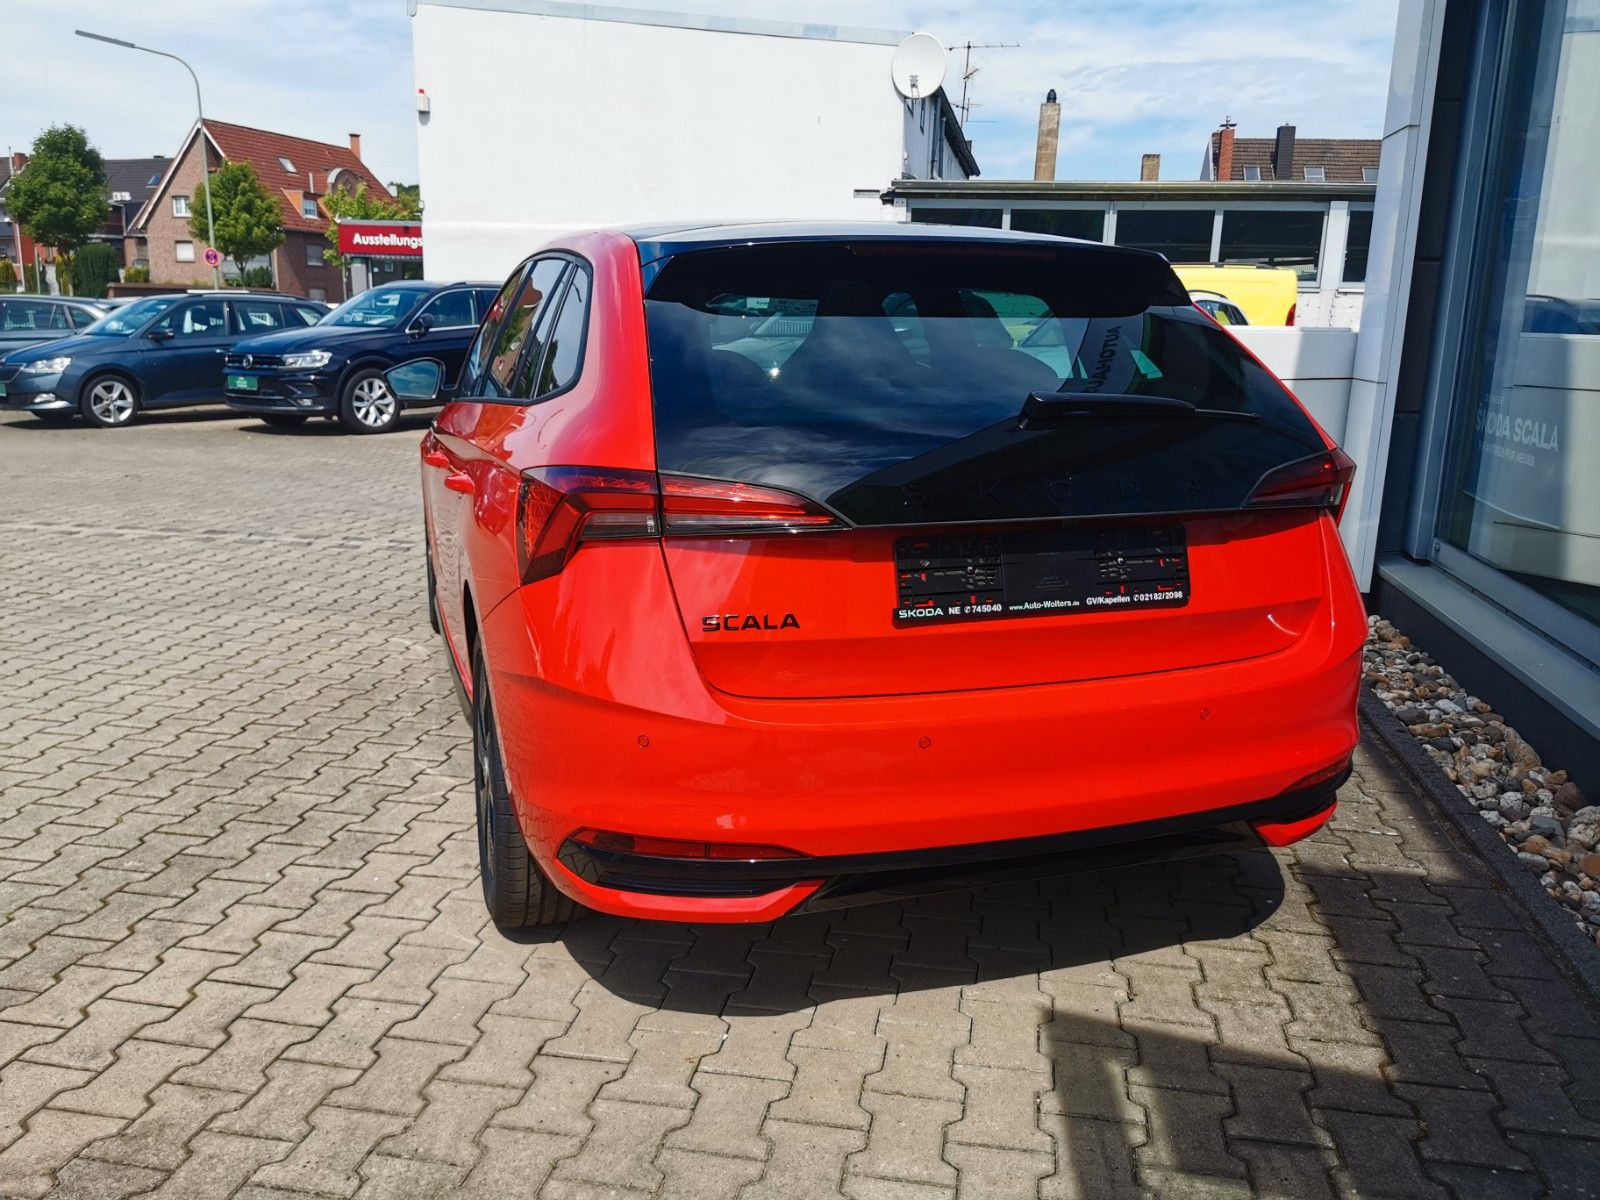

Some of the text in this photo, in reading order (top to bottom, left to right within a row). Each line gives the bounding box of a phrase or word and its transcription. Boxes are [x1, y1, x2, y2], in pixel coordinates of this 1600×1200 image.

[1513, 418, 1559, 452] SCALA
[948, 606, 961, 615] NE
[702, 612, 800, 632] SCALA
